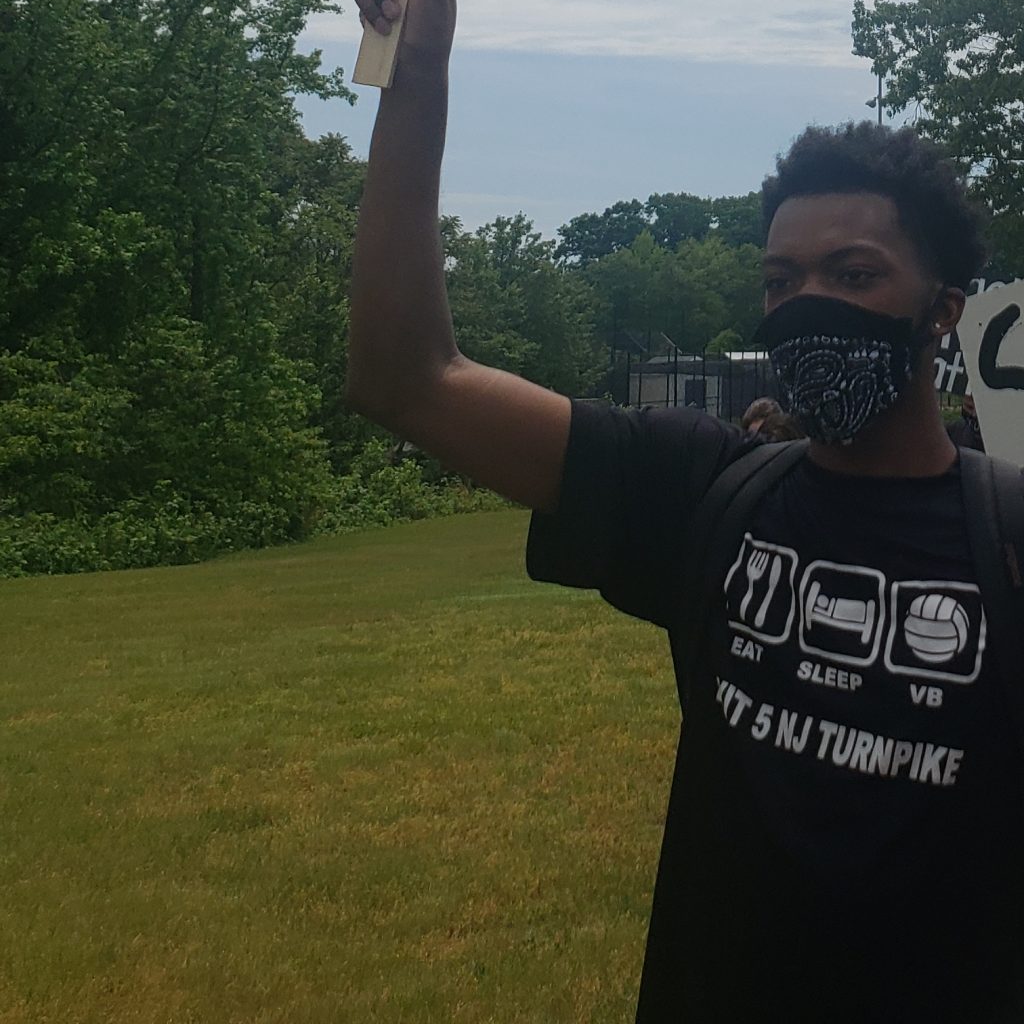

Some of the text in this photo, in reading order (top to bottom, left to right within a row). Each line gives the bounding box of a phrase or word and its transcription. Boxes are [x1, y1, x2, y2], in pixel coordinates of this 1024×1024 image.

[731, 636, 763, 662] EAT
[797, 660, 862, 691] SLEEP
[909, 683, 943, 708] VB
[751, 703, 774, 741] 5
[775, 708, 813, 754] NJ
[816, 720, 964, 786] TURNPIKE
